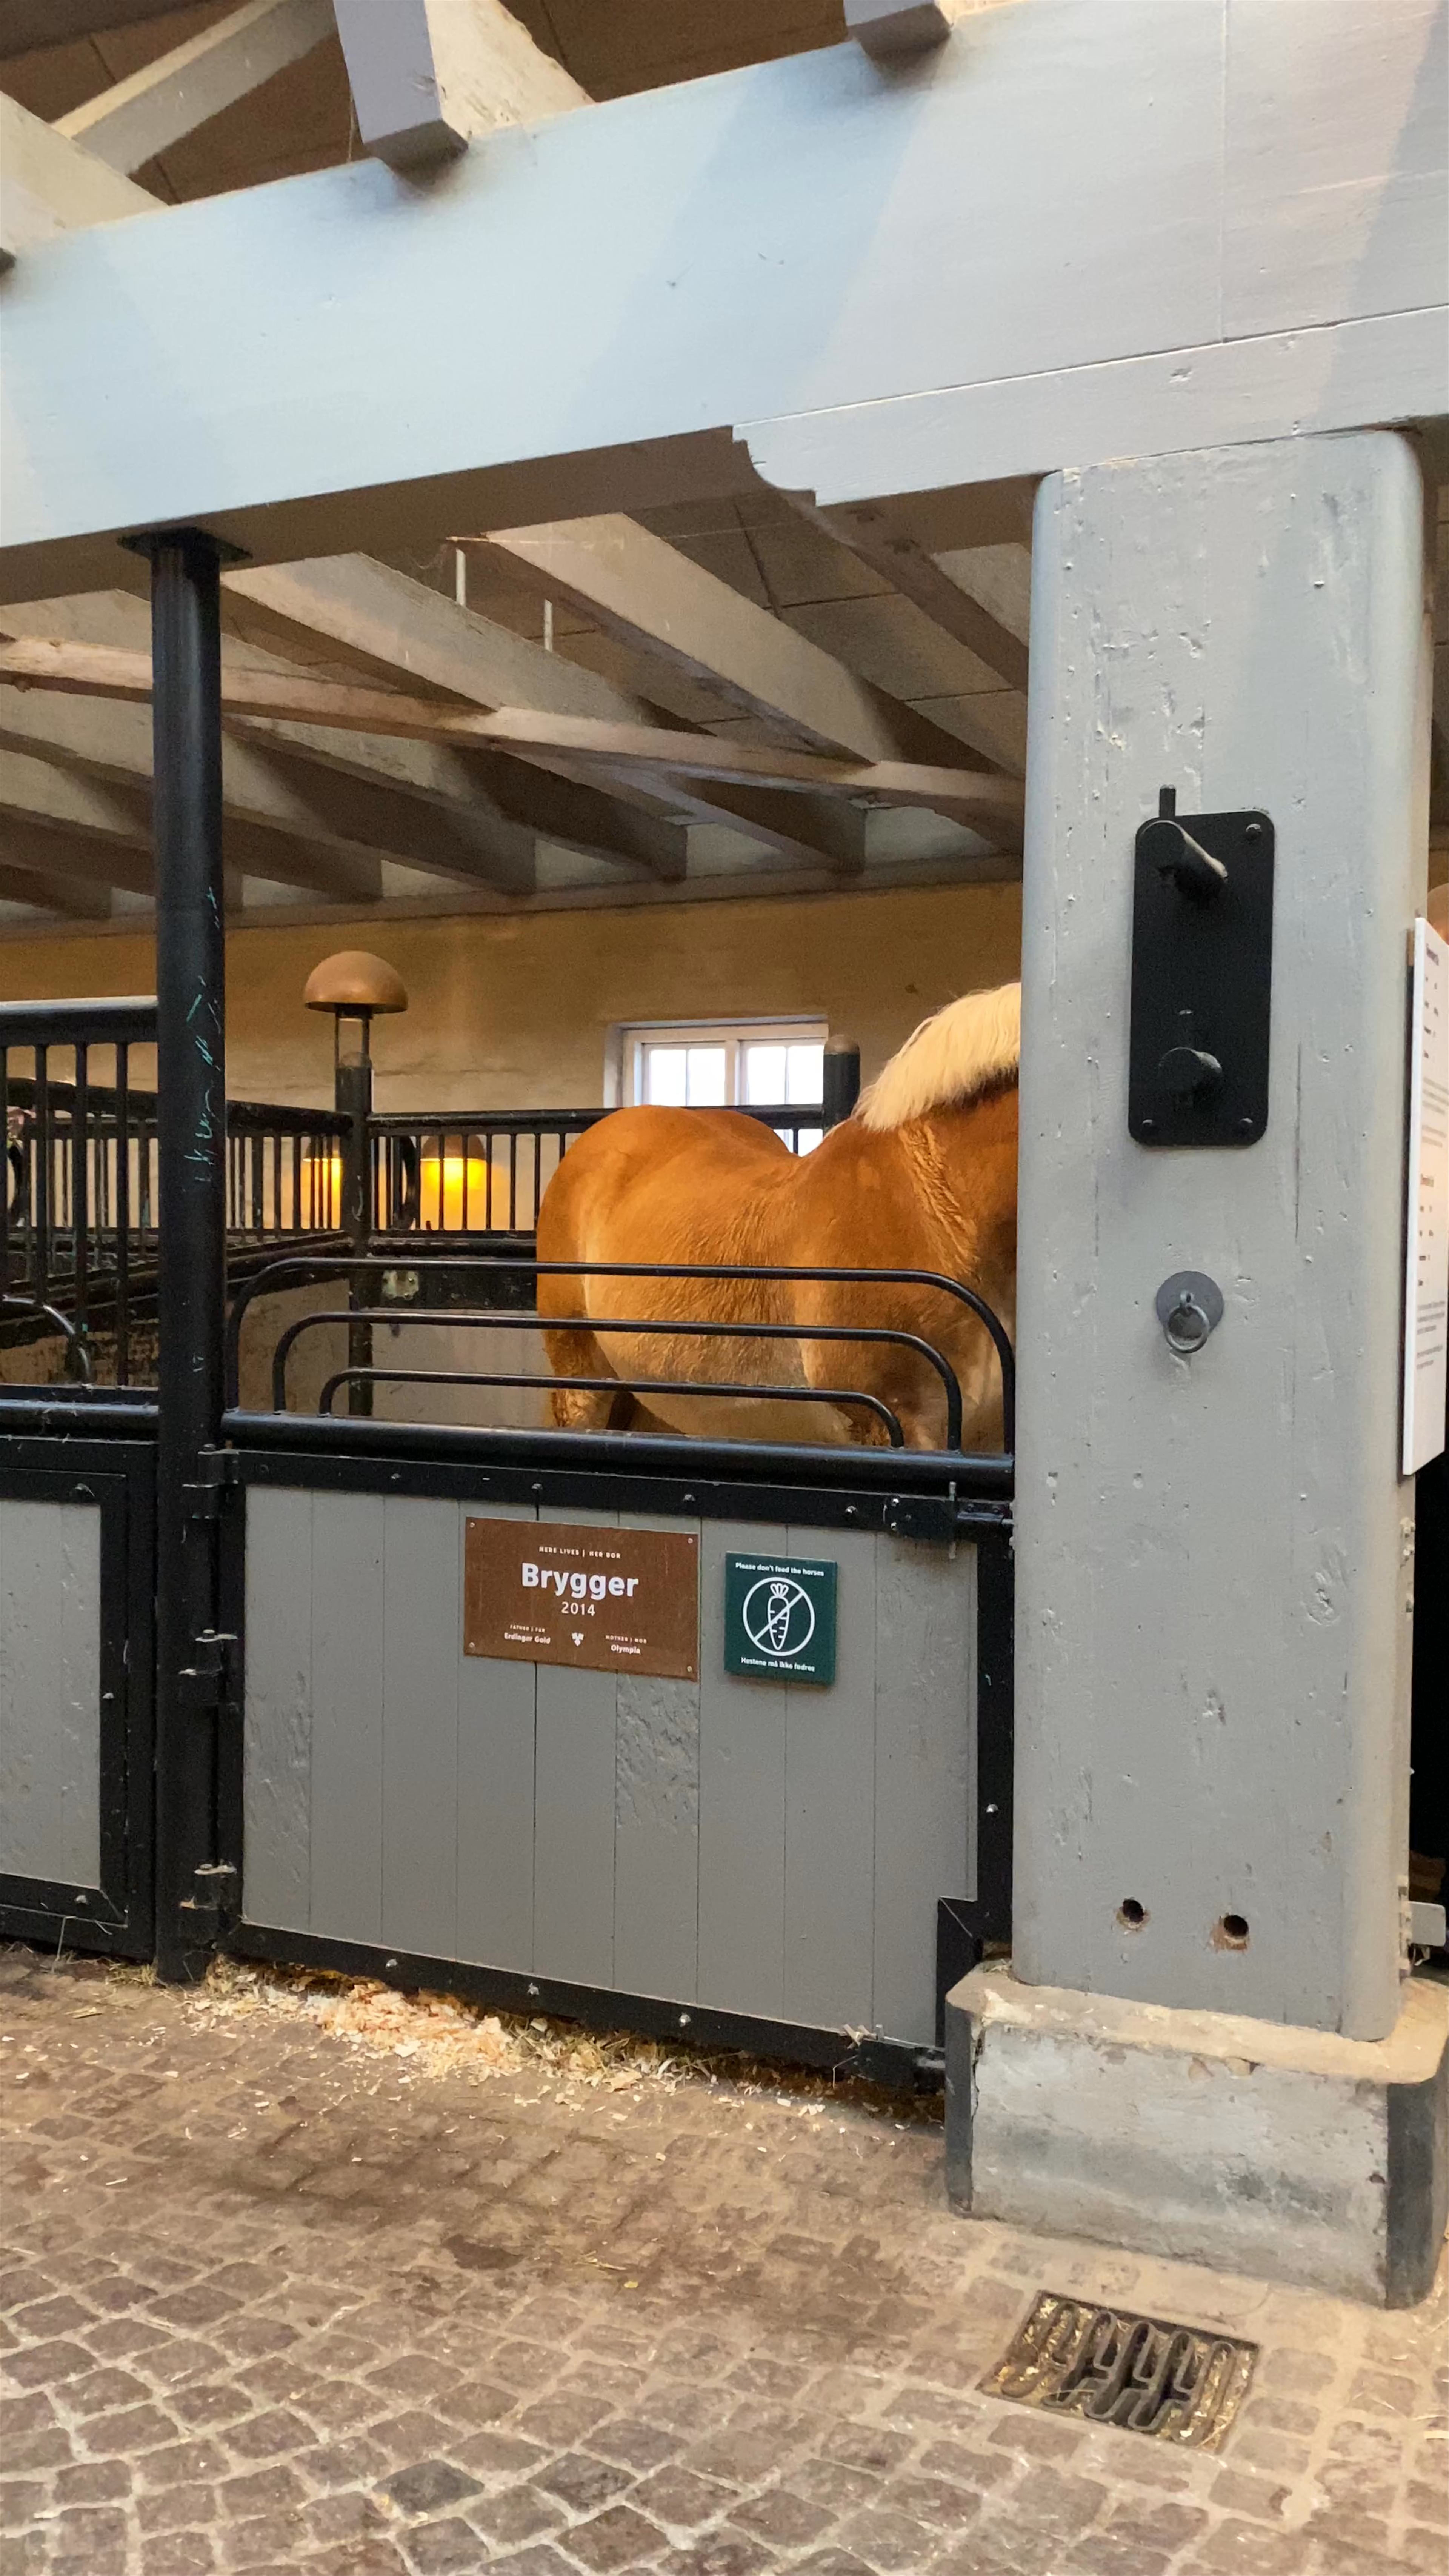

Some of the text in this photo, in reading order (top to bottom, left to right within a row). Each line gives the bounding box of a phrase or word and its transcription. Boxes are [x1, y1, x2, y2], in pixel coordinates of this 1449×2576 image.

[803, 1568, 824, 1576] horses
[522, 1563, 639, 1600] Brygger
[561, 1601, 595, 1616] 2014
[611, 1644, 641, 1655] Olympia
